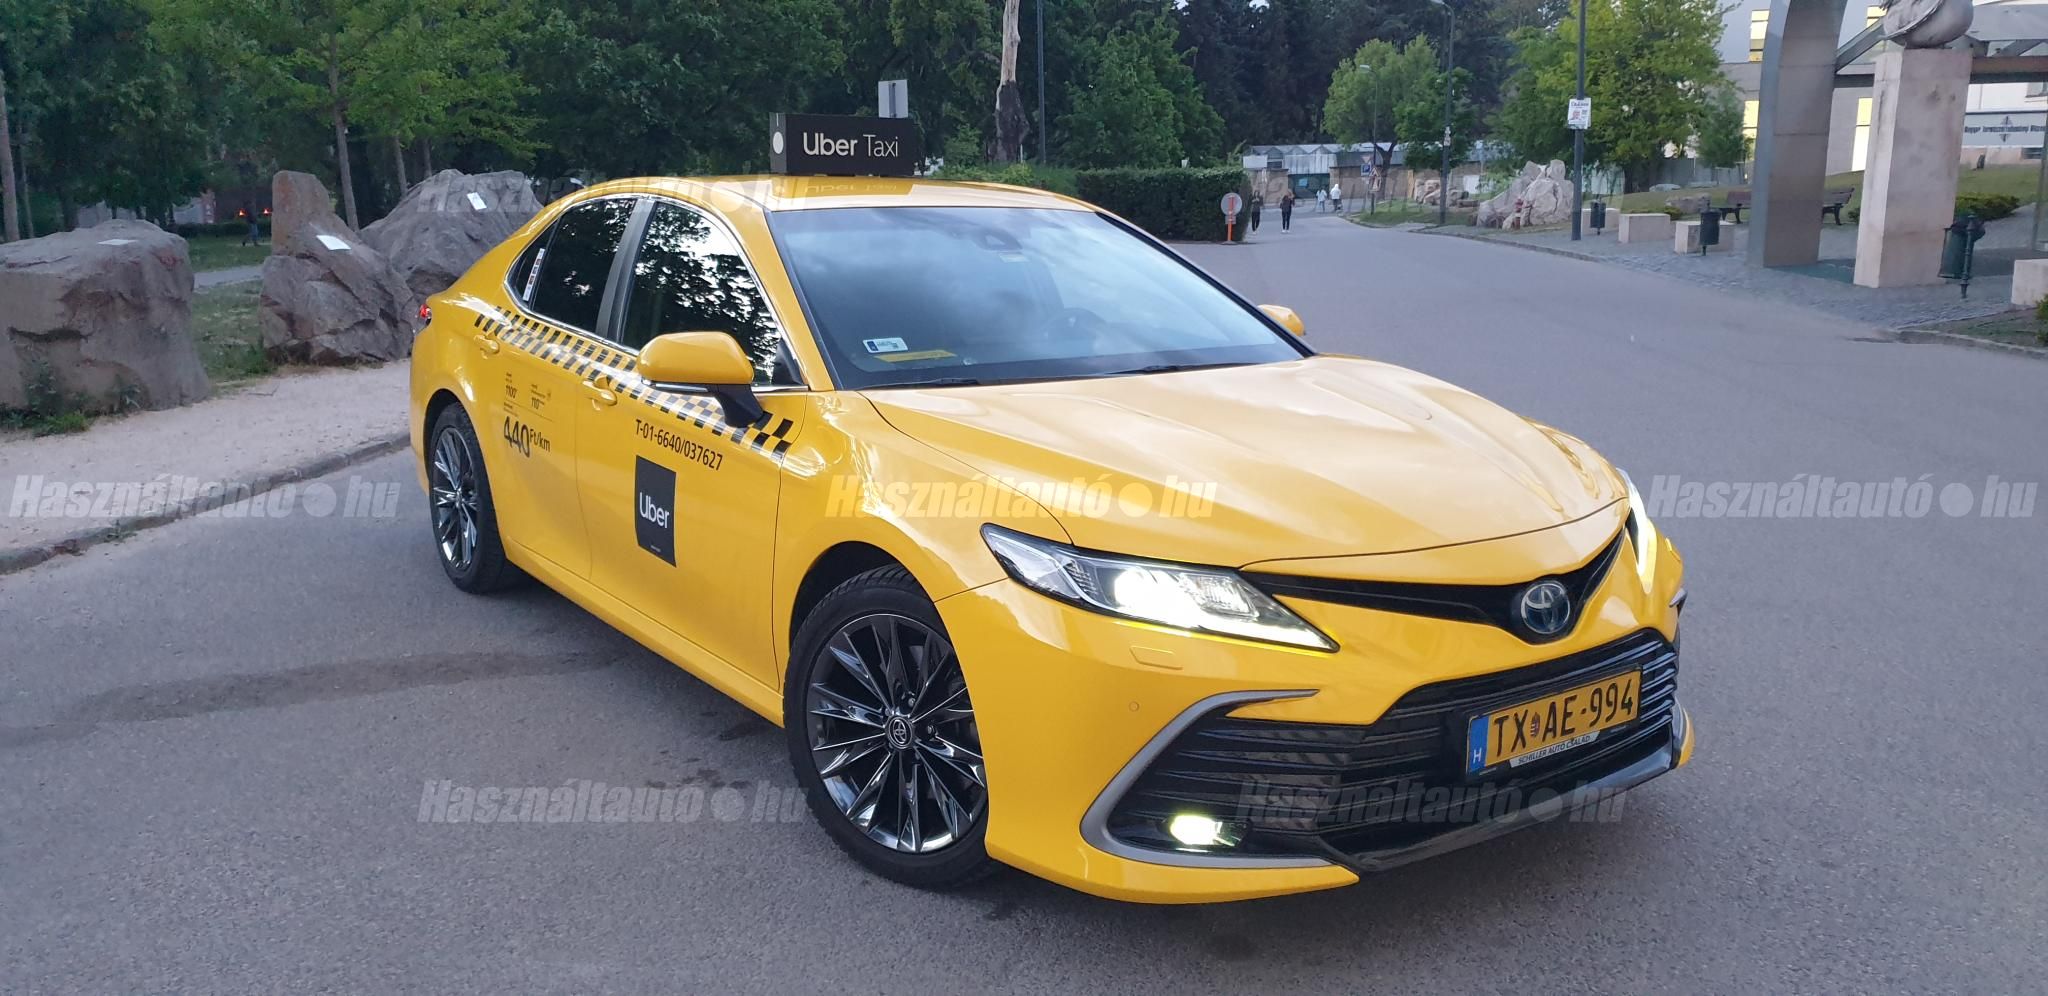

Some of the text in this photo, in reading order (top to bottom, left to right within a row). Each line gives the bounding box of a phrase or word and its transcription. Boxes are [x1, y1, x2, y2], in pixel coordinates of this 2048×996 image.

[803, 132, 899, 157] Uber Taxi
[504, 416, 551, 458] 440 Ft/km
[636, 418, 723, 471] T-01-6640/037627
[640, 492, 670, 529] Uber
[1494, 679, 1633, 757] TX AE-994
[1473, 747, 1482, 763] H
[1518, 749, 1547, 764] SCHILLER
